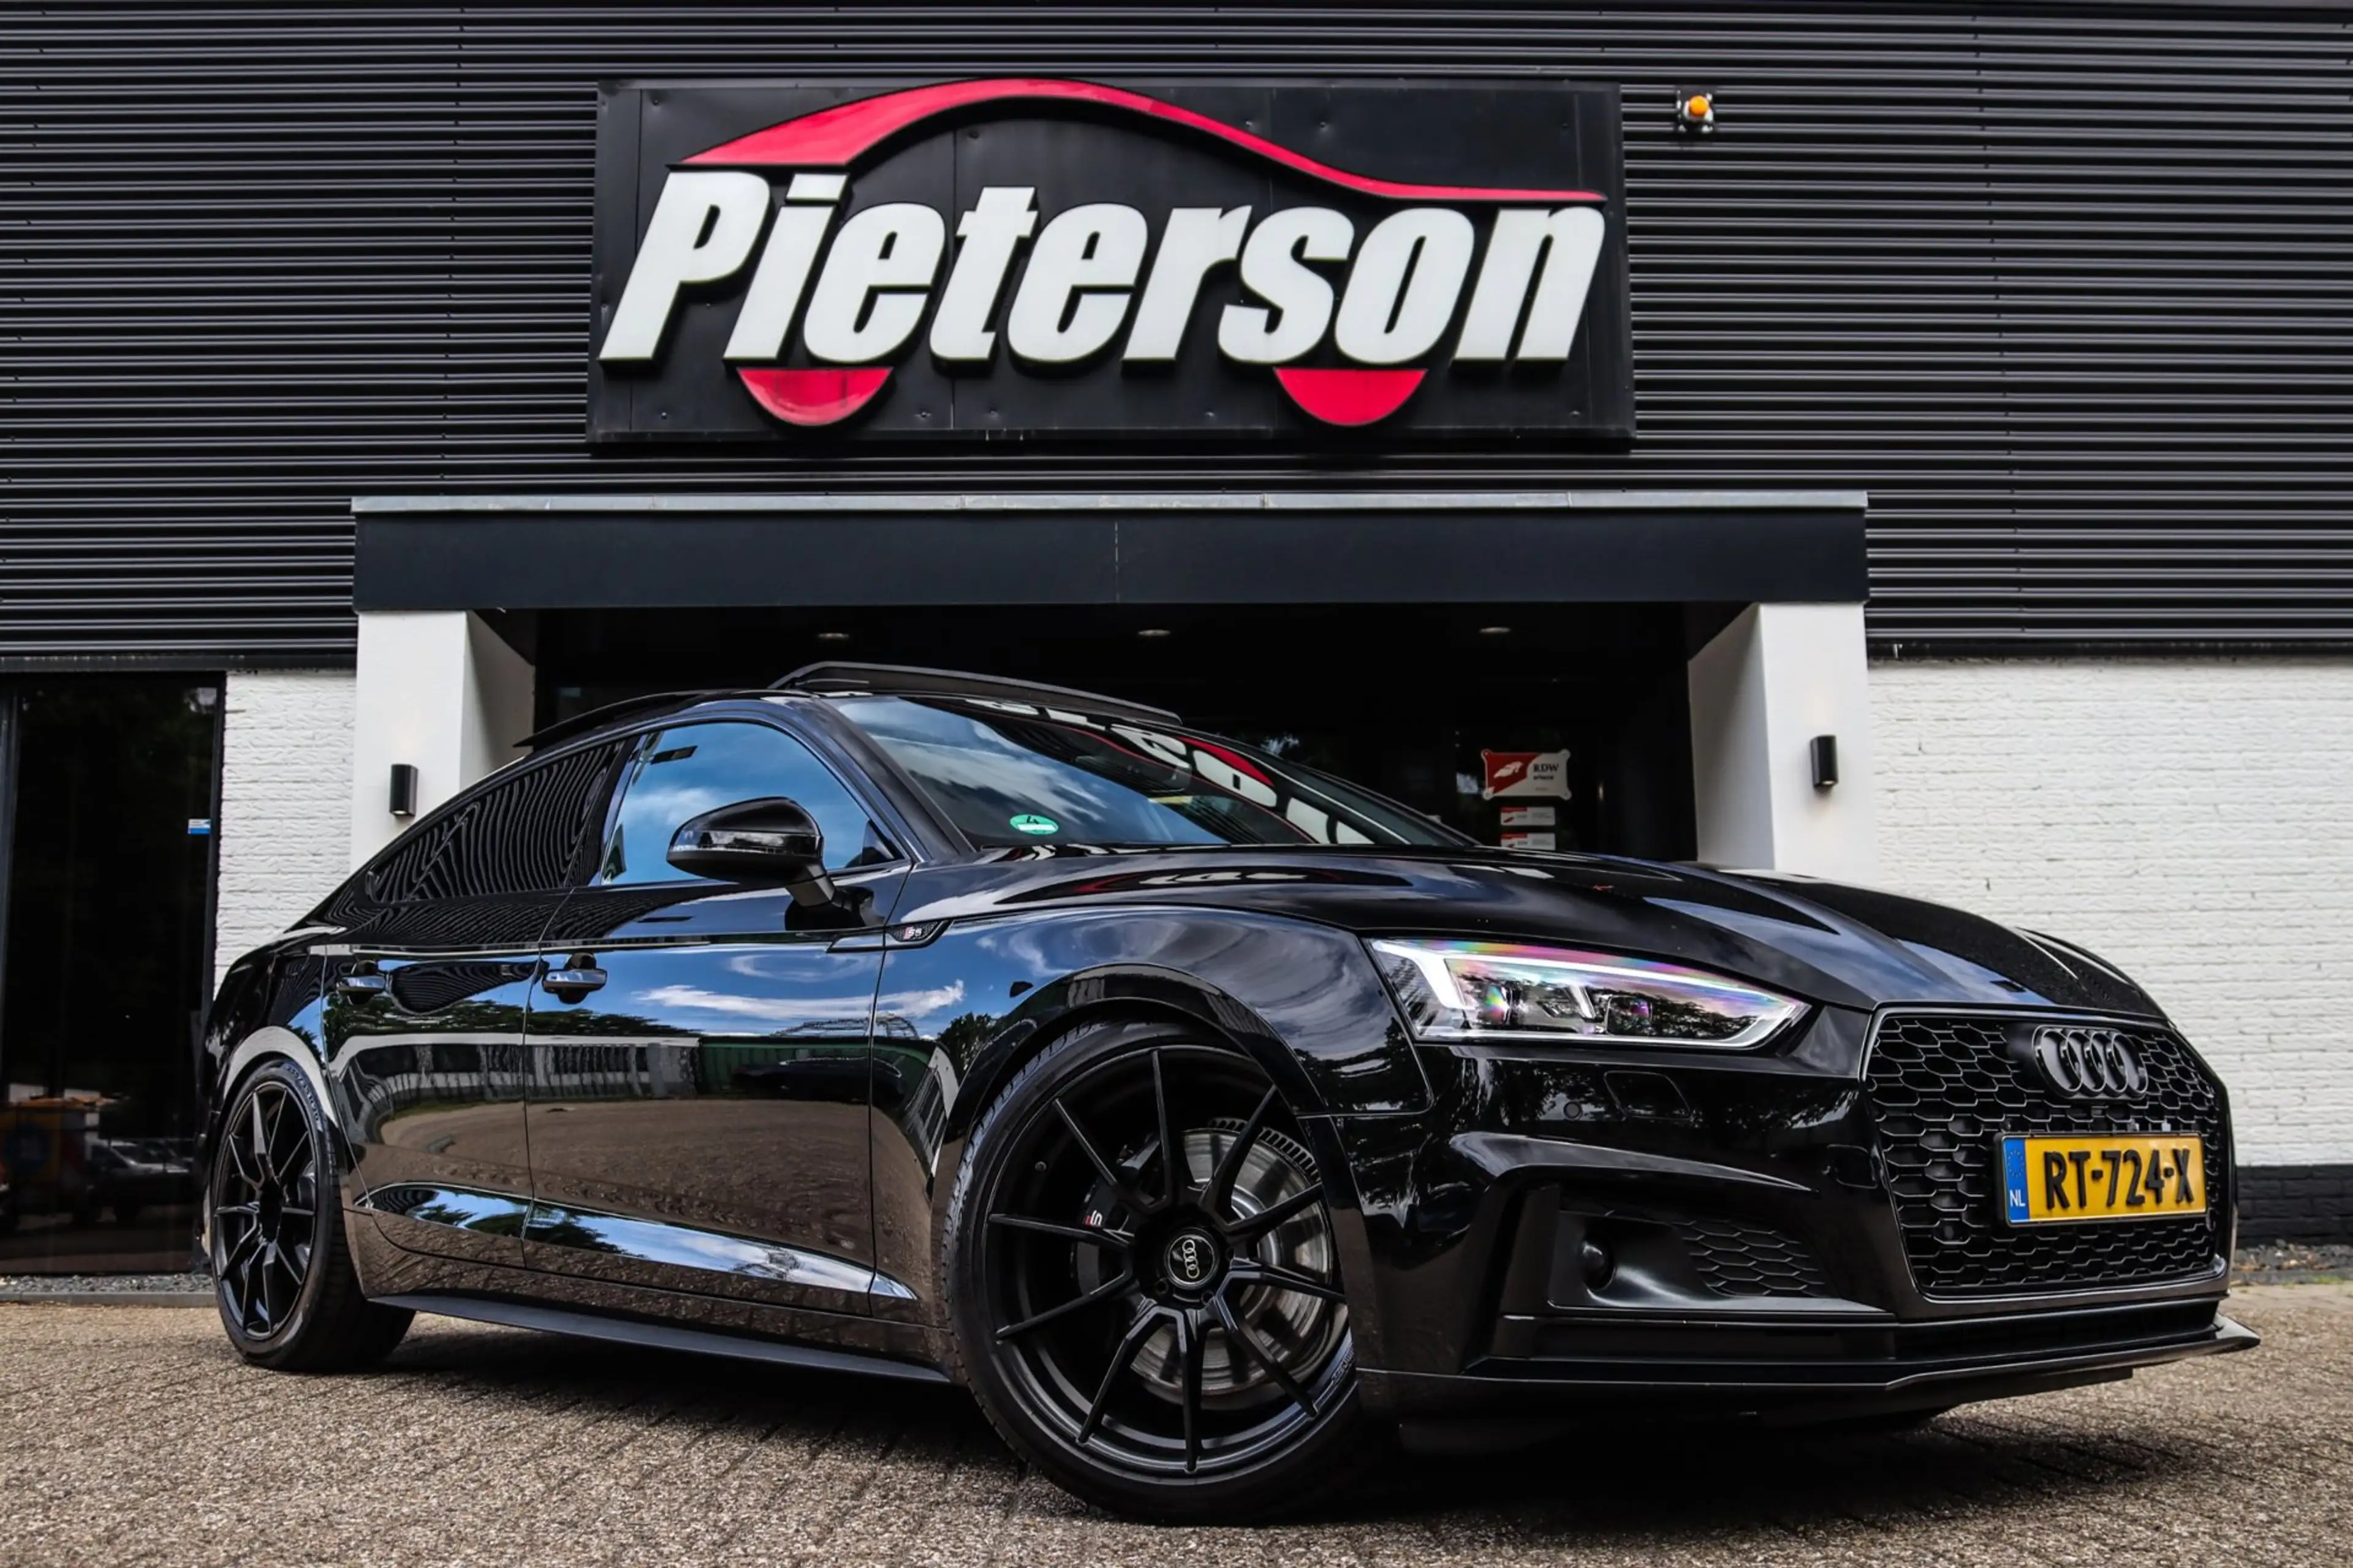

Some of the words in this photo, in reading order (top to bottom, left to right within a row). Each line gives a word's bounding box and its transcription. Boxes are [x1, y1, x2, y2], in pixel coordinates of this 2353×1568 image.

[599, 169, 1605, 365] Pieterson
[1533, 763, 1559, 773] RDW
[2009, 1189, 2026, 1207] NL
[2043, 1148, 2195, 1210] RT-724-X
